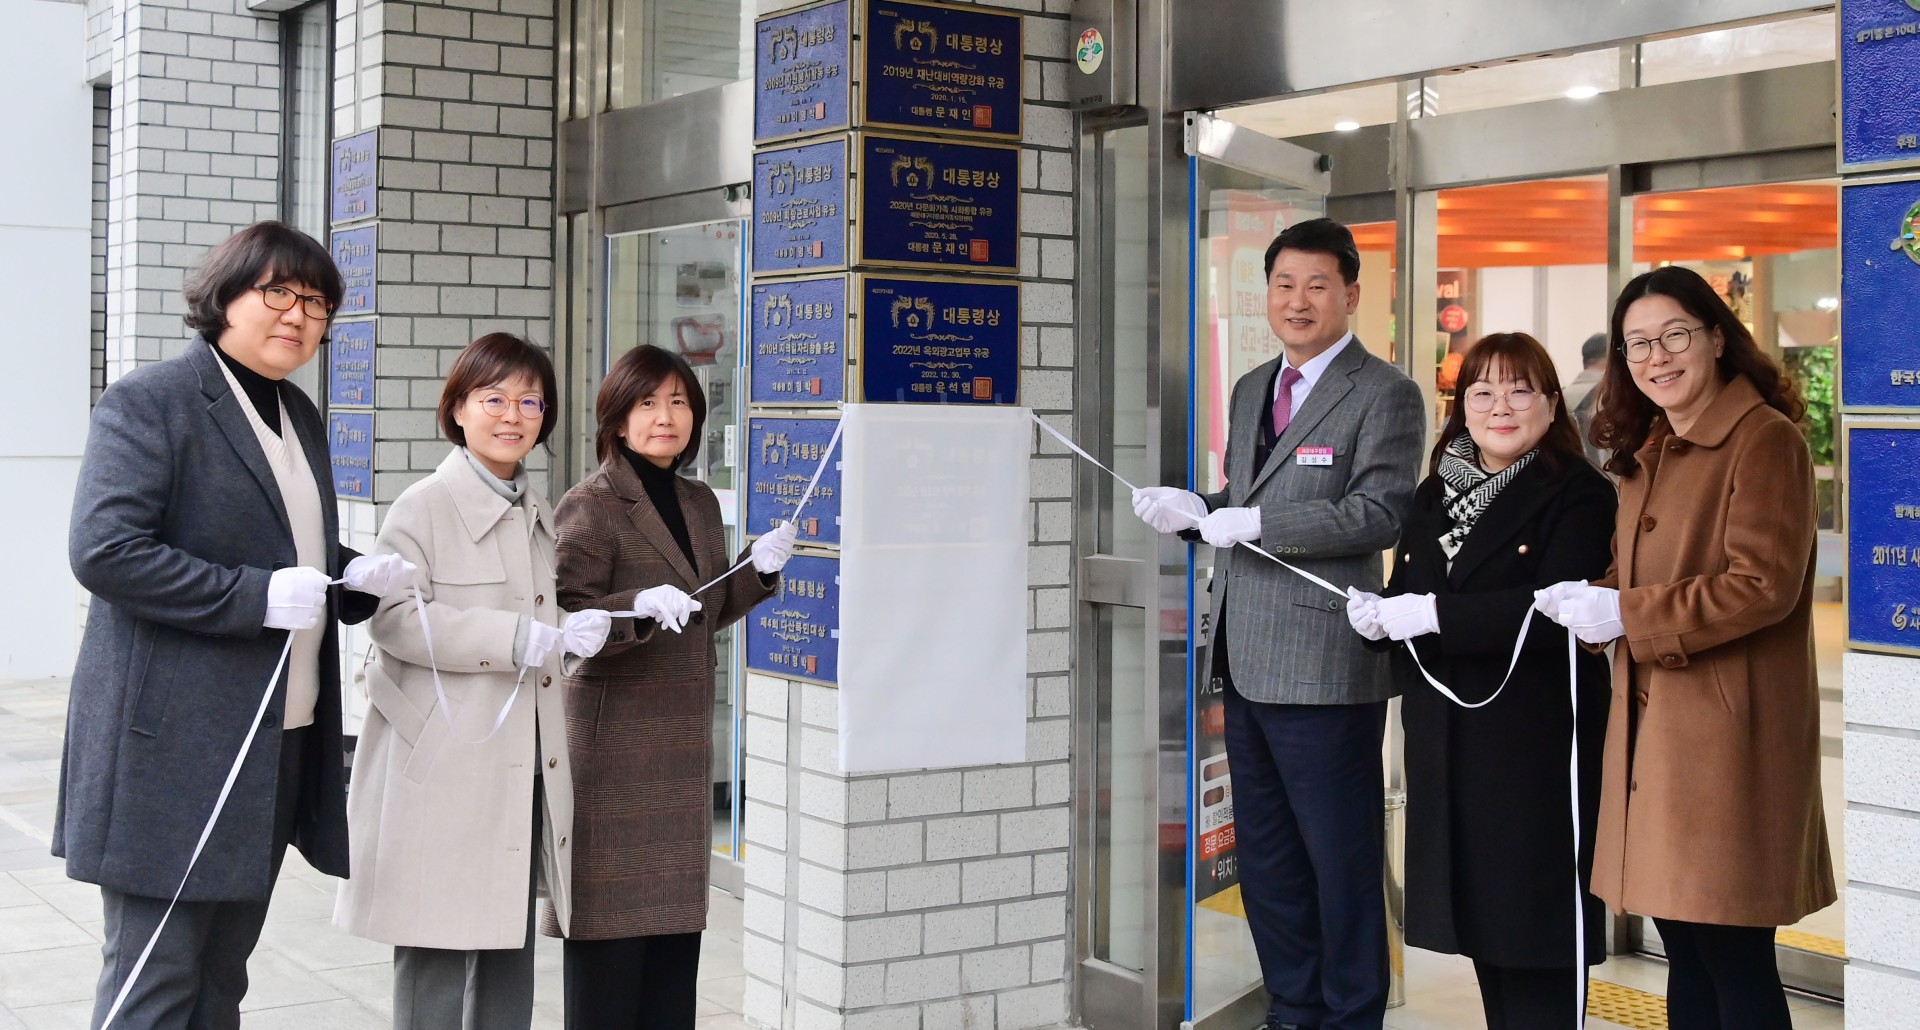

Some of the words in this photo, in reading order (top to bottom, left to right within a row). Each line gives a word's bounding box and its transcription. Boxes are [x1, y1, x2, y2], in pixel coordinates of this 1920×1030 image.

[800, 26, 834, 47] 대통령상
[946, 34, 1002, 55] 대통령상
[826, 65, 838, 78] 유공
[883, 66, 913, 79] 2019년
[916, 69, 985, 87] 재난대비역량강화
[988, 76, 1004, 89] 유공
[931, 93, 948, 101] 2020.
[911, 106, 932, 116] 대통령
[797, 164, 832, 184] 대통령상
[943, 168, 1000, 189] 대통령상
[762, 210, 783, 224] 2009년
[784, 205, 821, 221] 희망근로사업
[823, 204, 836, 217] 유공
[890, 201, 914, 211] 2020년
[916, 203, 949, 213] 다문화가족
[980, 208, 993, 217] 유공
[908, 243, 929, 253] 대통령
[796, 302, 833, 320] 대통령상
[943, 307, 1000, 326] 대통령상
[759, 343, 778, 355] 2010년
[780, 342, 821, 355] 지역일자리창출
[824, 342, 836, 354] 유공
[892, 345, 920, 356] 2022년
[924, 346, 971, 358] 옥외광고업무
[973, 348, 989, 358] 유공
[912, 383, 932, 393] 대통령
[756, 482, 775, 495] 2011년
[822, 487, 833, 499] 우수
[1873, 546, 1907, 566] 2011년
[789, 579, 825, 599] 대통령상
[760, 616, 779, 630] 제4회
[781, 620, 825, 638] 다산목민대상
[1205, 835, 1217, 853] 정문
